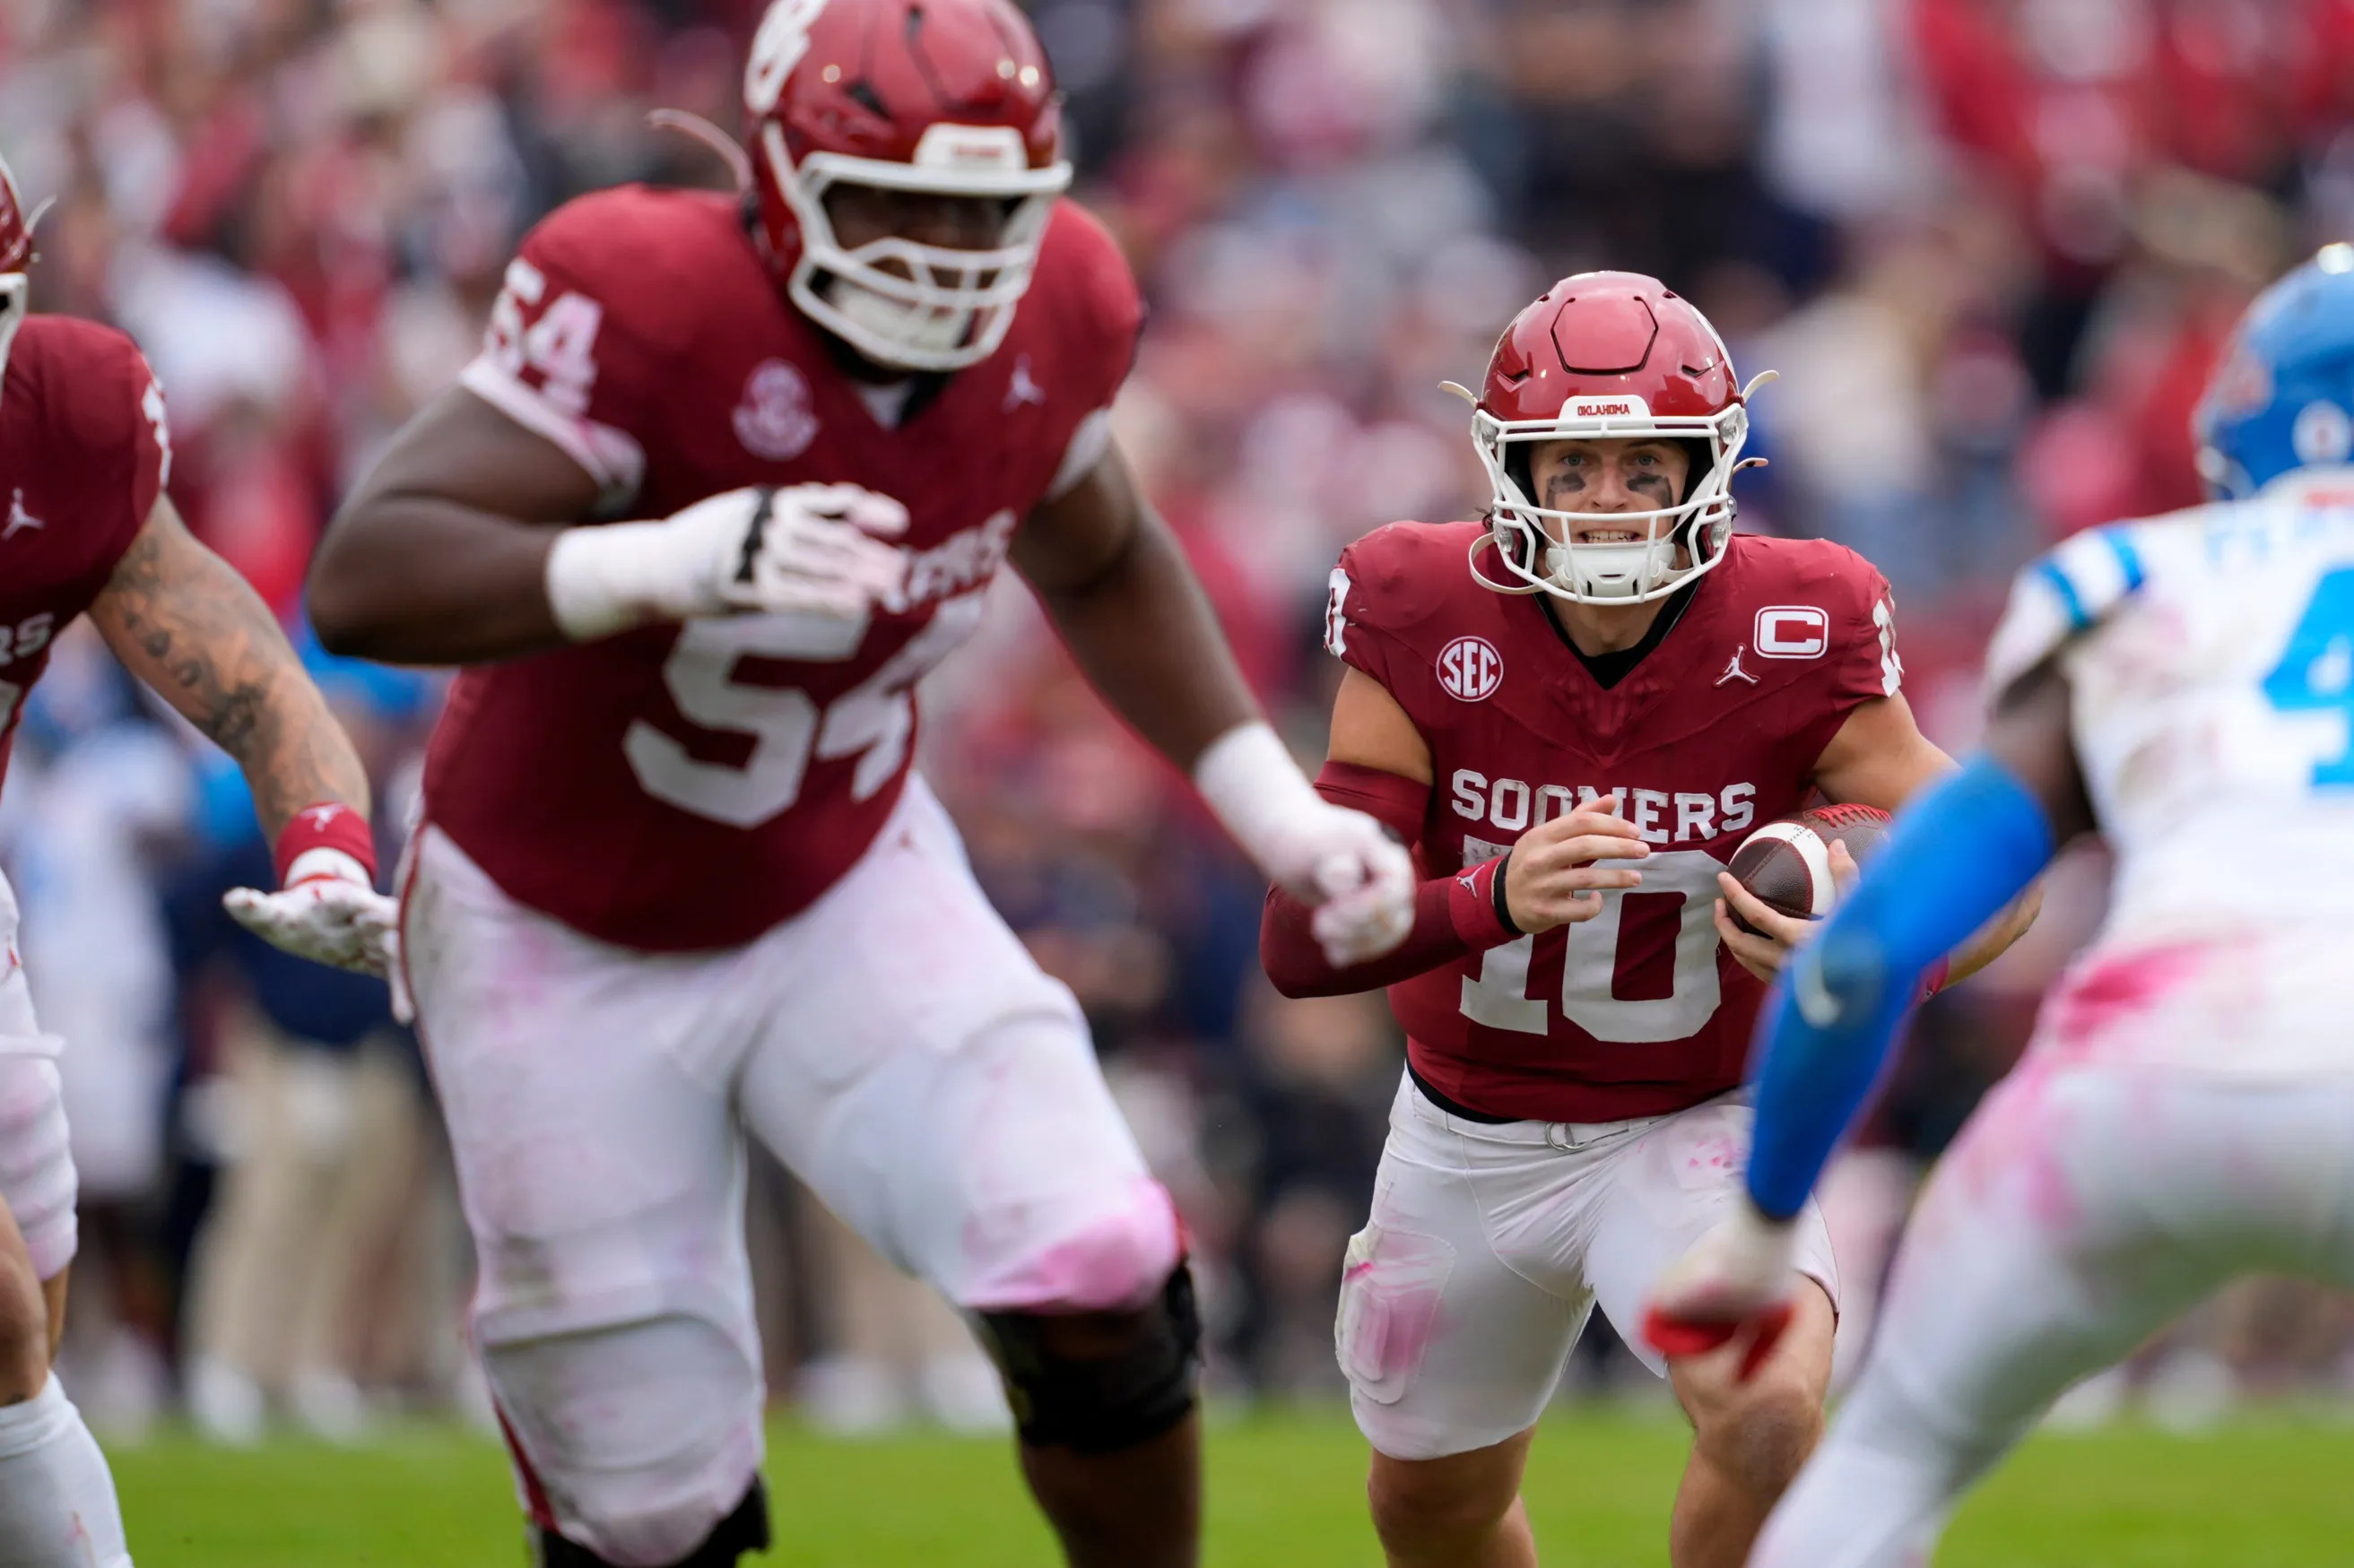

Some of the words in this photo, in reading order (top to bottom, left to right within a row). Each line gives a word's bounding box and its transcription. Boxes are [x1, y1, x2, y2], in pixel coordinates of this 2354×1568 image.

[1577, 403, 1631, 417] OKLAHOMA
[1759, 611, 1822, 654] C
[1442, 641, 1497, 697] SEC
[622, 597, 981, 830] 54
[1459, 834, 1729, 1044] 10
